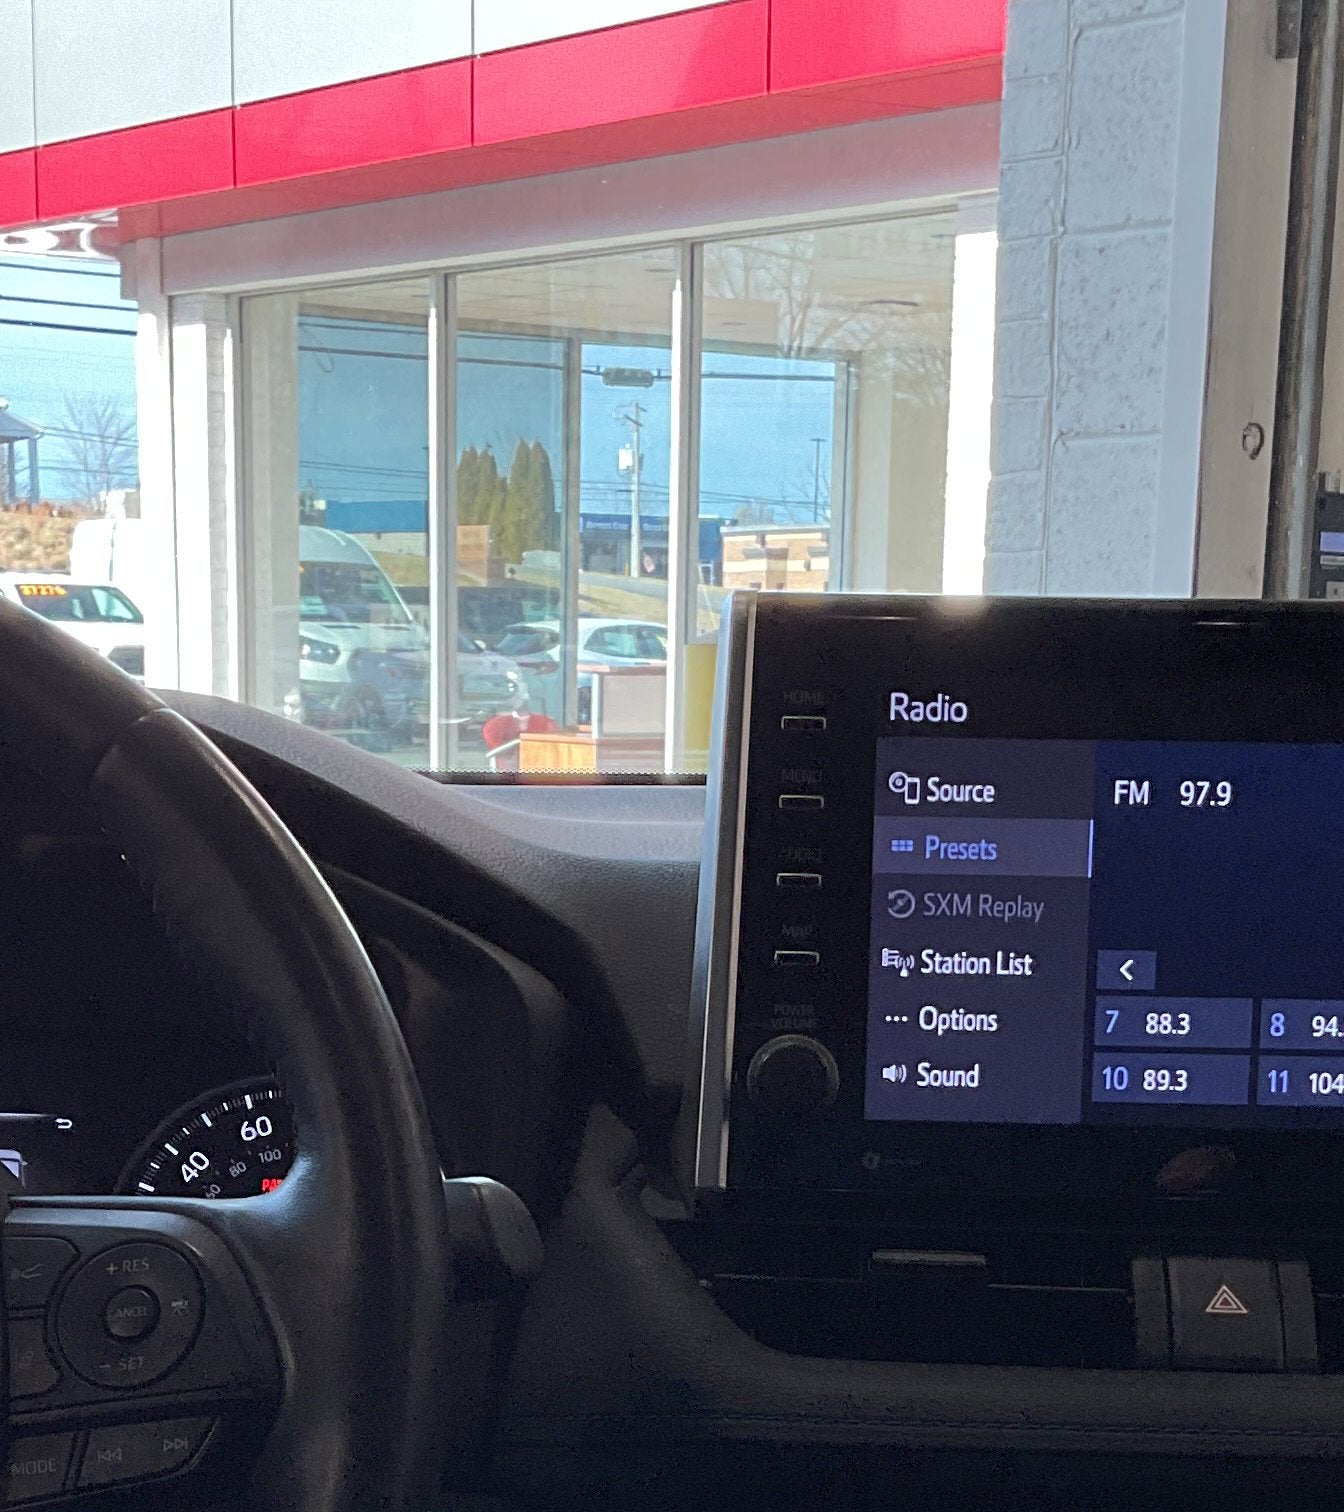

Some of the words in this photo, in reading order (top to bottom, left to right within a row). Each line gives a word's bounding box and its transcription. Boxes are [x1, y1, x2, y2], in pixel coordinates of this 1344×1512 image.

[890, 693, 967, 722] Radio
[927, 777, 995, 803] Source
[1114, 780, 1150, 805] FM
[1180, 780, 1232, 807] 97.9
[925, 835, 997, 861] Presets
[923, 893, 972, 917] SXM
[978, 893, 1044, 923] Replay
[920, 949, 990, 975] Station
[995, 950, 1034, 975] List
[918, 1006, 998, 1036] Options
[1106, 1010, 1119, 1034] 7
[1145, 1012, 1191, 1035] 88.3
[1269, 1013, 1285, 1037] 8
[916, 1062, 979, 1088] Sound
[1103, 1066, 1129, 1091] 10
[1143, 1069, 1188, 1092] 89.3
[1268, 1070, 1289, 1094] 11
[240, 1115, 273, 1142] 60
[182, 1152, 209, 1182] 40
[258, 1149, 282, 1164] 100
[229, 1162, 247, 1178] 80
[122, 1258, 150, 1272] RES
[118, 1356, 144, 1371] SET
[11, 1459, 56, 1475] MODE
